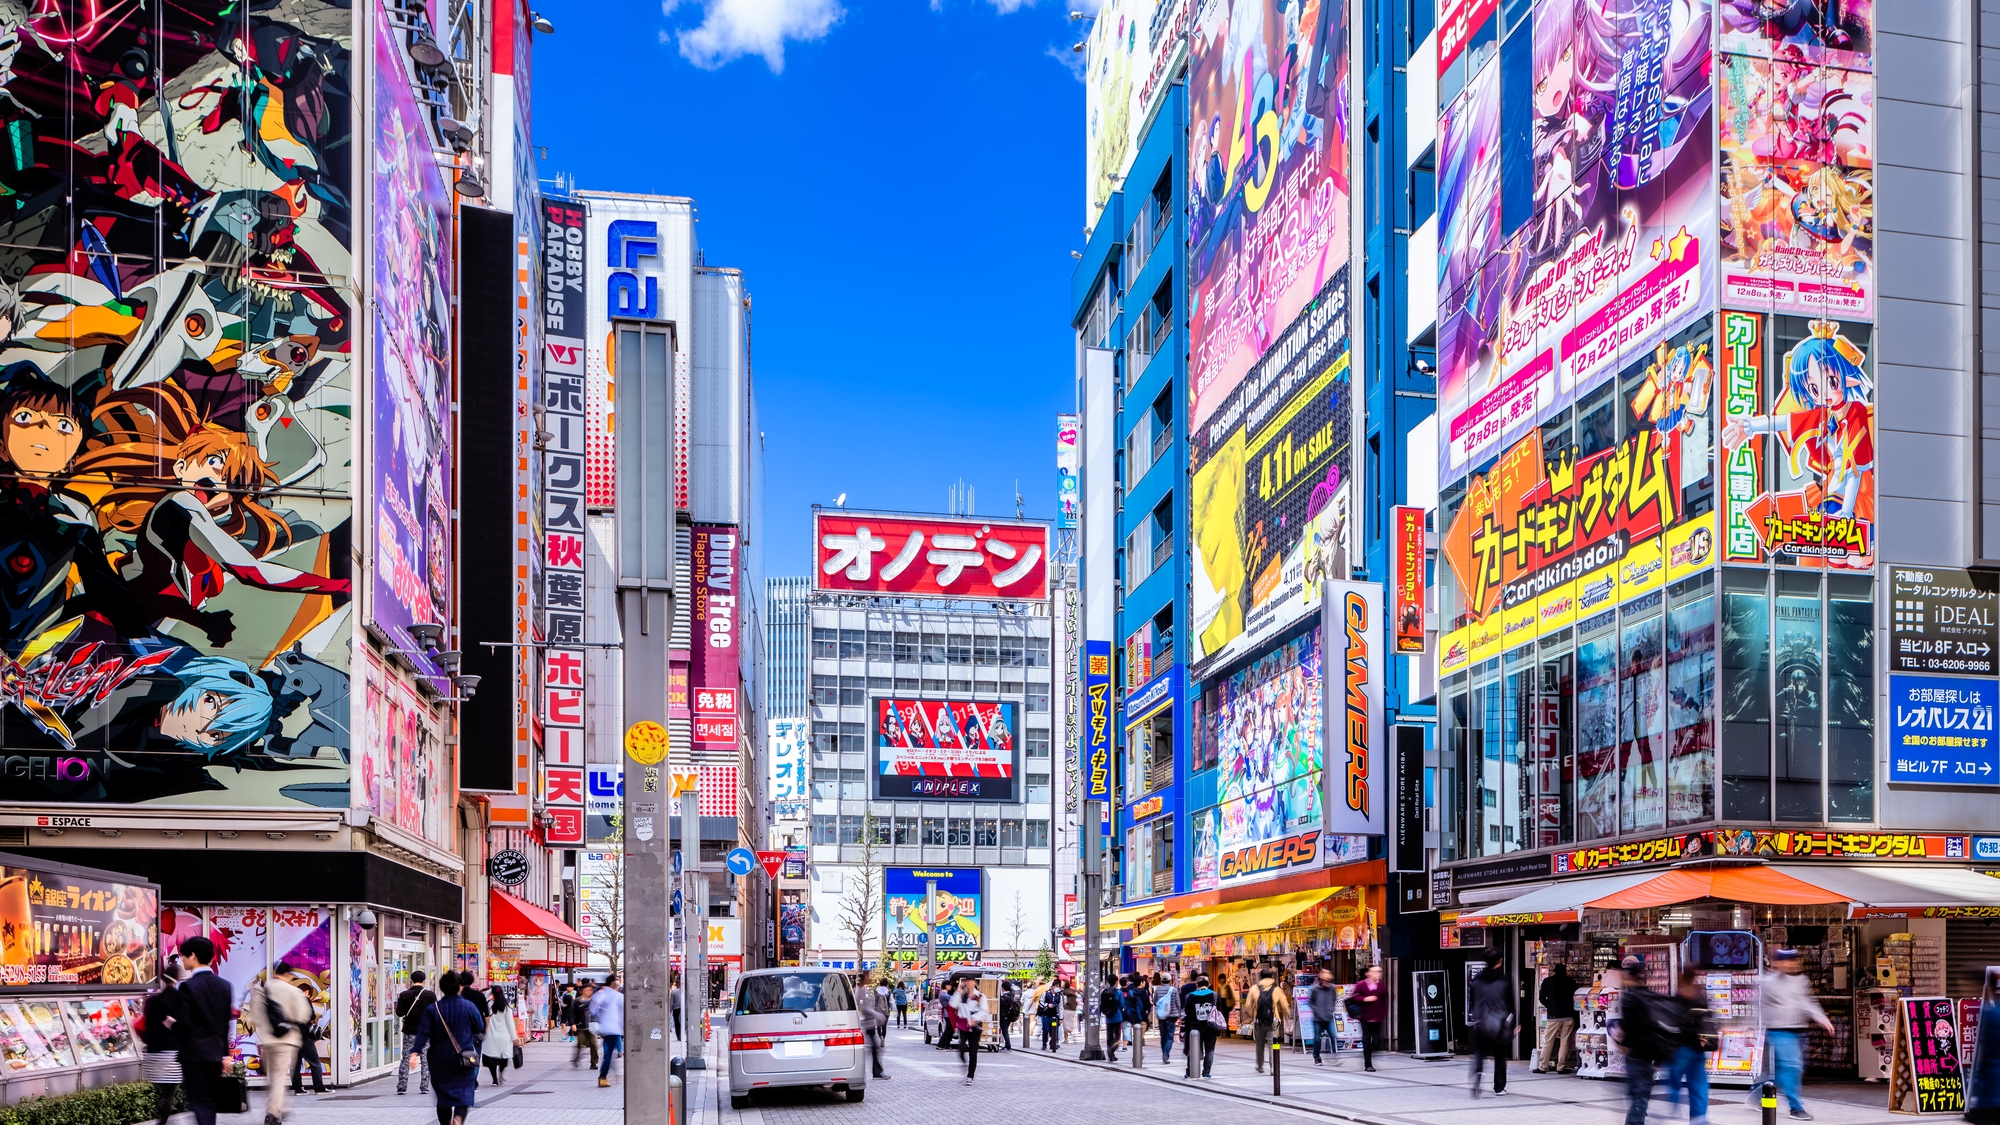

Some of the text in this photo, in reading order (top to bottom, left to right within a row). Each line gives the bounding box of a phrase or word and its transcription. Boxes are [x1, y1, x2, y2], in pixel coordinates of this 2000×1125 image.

[1204, 151, 1321, 325] 第二部、好評配信中!
[565, 209, 583, 293] HOBBY
[546, 206, 565, 331] PARADISE
[1209, 283, 1345, 448] Persona4 the ANIMATION Series
[1246, 313, 1346, 433] Complete Blu-ray Disc BOX
[1726, 313, 1758, 560] カードゲム専門店
[1259, 419, 1333, 503] 4.11 ON SALE
[1473, 430, 1676, 615] カードキングダム
[1764, 513, 1867, 556] カードキングダム
[821, 524, 1042, 588] オノデン
[1783, 542, 1845, 556] Cardkingdom
[1405, 522, 1416, 601] カードキングダム
[694, 532, 708, 621] Flagship Store
[1895, 570, 1933, 583] 不動産の
[707, 534, 736, 648] Duty Free
[1895, 583, 1996, 600] トータルコンサルタント
[1934, 604, 1995, 626] iDEAL
[1940, 626, 1961, 635] 株式会社
[1900, 639, 1977, 655] 当ビル 8F 入口
[1090, 656, 1107, 675] 薬
[1928, 658, 1990, 671] 03-6206-9966
[697, 692, 733, 710] 免税
[1909, 688, 1981, 704] お部屋探しは
[1343, 591, 1370, 823] GAMERS
[1897, 704, 1993, 731] レオパレス21
[697, 722, 733, 737] 면세점
[1088, 683, 1109, 795] マツモトキヨシ
[1902, 734, 1988, 748] 全国のお部屋探せます
[0, 755, 111, 782] GELION
[775, 722, 793, 797] テレオン
[1897, 759, 1976, 775] 当ビル 7F 入口
[914, 781, 980, 793] ANIPLEX
[587, 800, 615, 809] Home
[52, 817, 91, 827] ESPACE
[1587, 837, 1681, 868] カードキングダム
[1793, 833, 1926, 857] カードキングダム
[1978, 841, 2000, 853] 防犯
[494, 851, 526, 864] SMOKER'S
[1219, 829, 1323, 880] GAMERS
[508, 871, 526, 884] STAND
[912, 870, 944, 878] Welcome
[1457, 870, 1483, 880] ALIENWARE
[1483, 868, 1498, 877] STORE
[1499, 867, 1514, 875] AKIBA
[1538, 862, 1548, 870] Site
[45, 885, 117, 912] 銀座ライオン
[887, 932, 977, 946] AKIBARA
[975, 961, 1002, 969] Canon
[1002, 961, 1028, 969] SONY
[1911, 1021, 1933, 1037] 売買
[1914, 1040, 1937, 1057] 店舗
[1916, 1058, 1939, 1075] 事務所
[1917, 1076, 1962, 1091] 不動産のことなら
[1919, 1090, 1965, 1111] アイデアル
